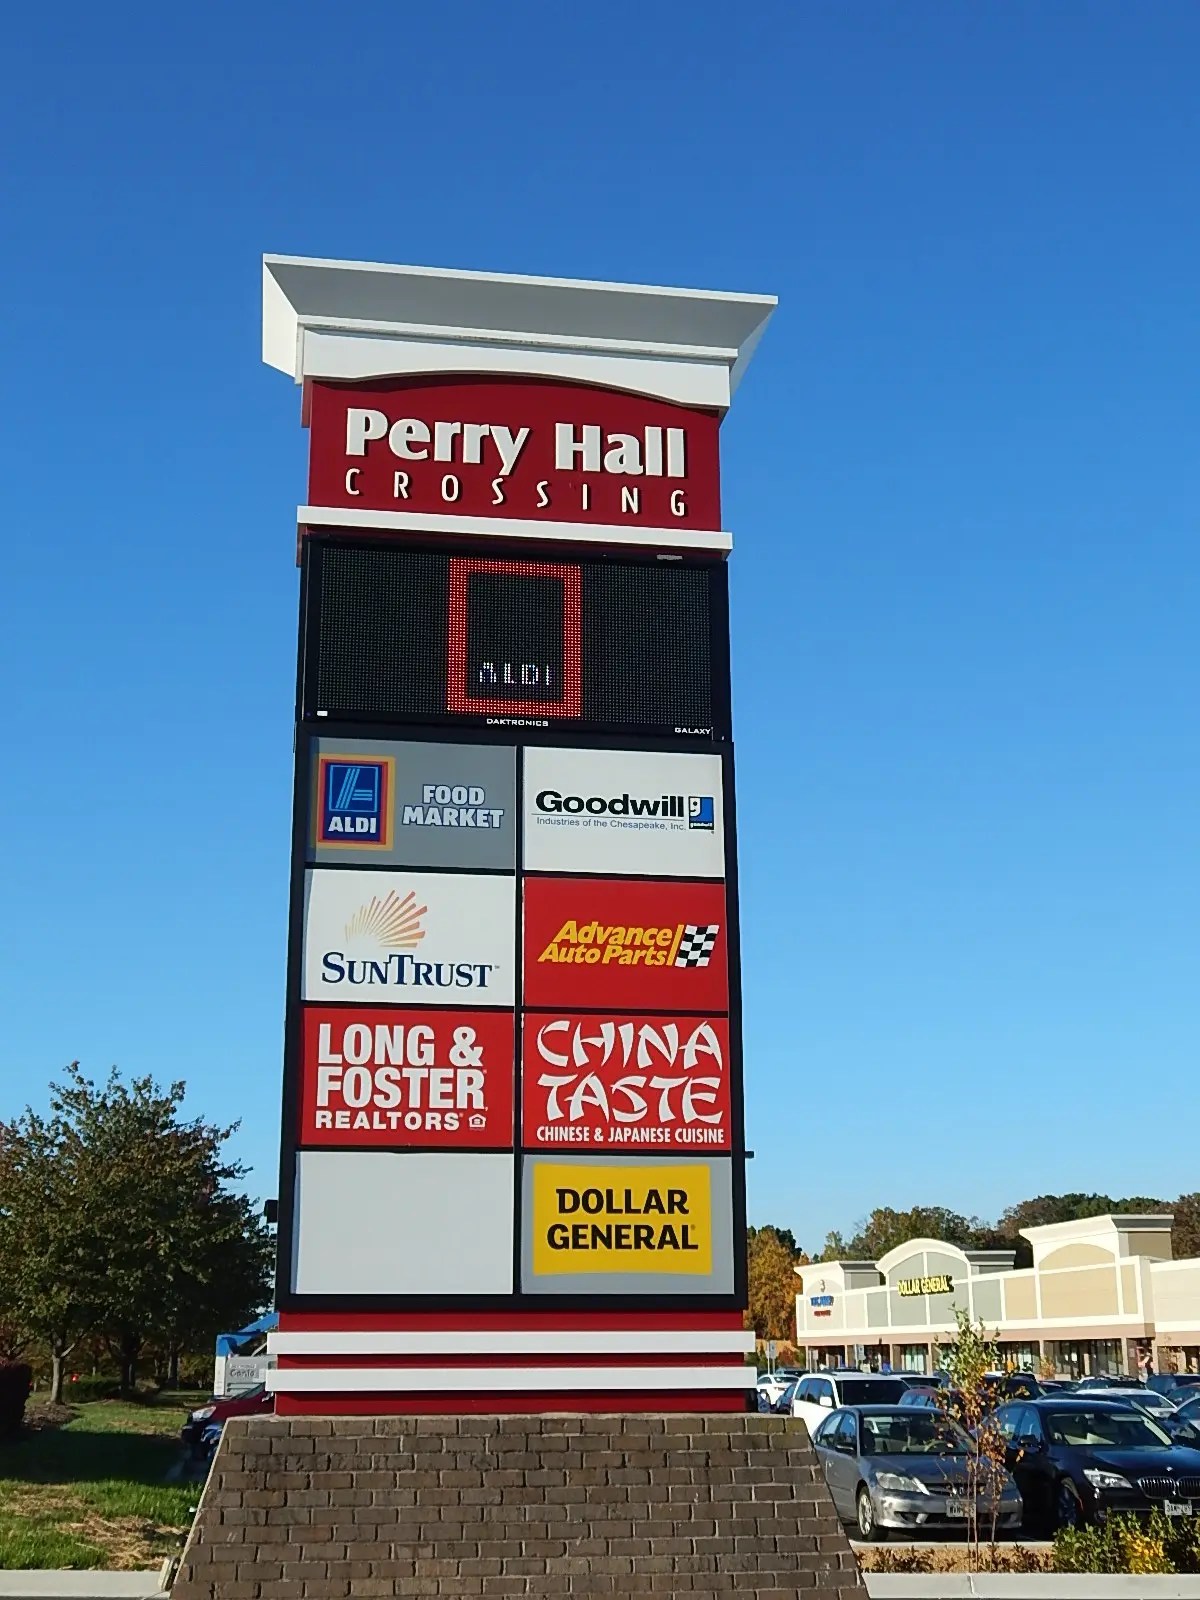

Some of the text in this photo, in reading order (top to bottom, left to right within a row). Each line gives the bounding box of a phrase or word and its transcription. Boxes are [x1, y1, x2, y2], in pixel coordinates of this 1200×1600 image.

[346, 408, 686, 478] Perry Hall
[345, 468, 687, 517] CROSSING
[479, 662, 550, 686] ALDI
[486, 718, 549, 727] DAKTRONICS
[674, 727, 711, 735] GALAXY
[422, 784, 486, 806] FOOD
[535, 790, 685, 818] Goodwill
[328, 816, 377, 834] ALDI
[402, 806, 504, 829] MARKET
[536, 817, 580, 826] Industries
[582, 819, 592, 827] of
[593, 820, 608, 828] the
[610, 821, 668, 831] Chesapeake,
[670, 823, 687, 831] Inc.
[552, 920, 673, 947] Advance
[537, 943, 668, 966] Auto Parts
[318, 1023, 484, 1067] LONG &
[536, 1020, 723, 1069] CHINA
[536, 1072, 724, 1124] TASTE
[315, 1110, 460, 1131] REALTORS
[536, 1126, 725, 1143] CHINESE & JAPANESE CUISINE
[555, 1189, 690, 1215] DOLLAR
[546, 1223, 699, 1251] GENERAL
